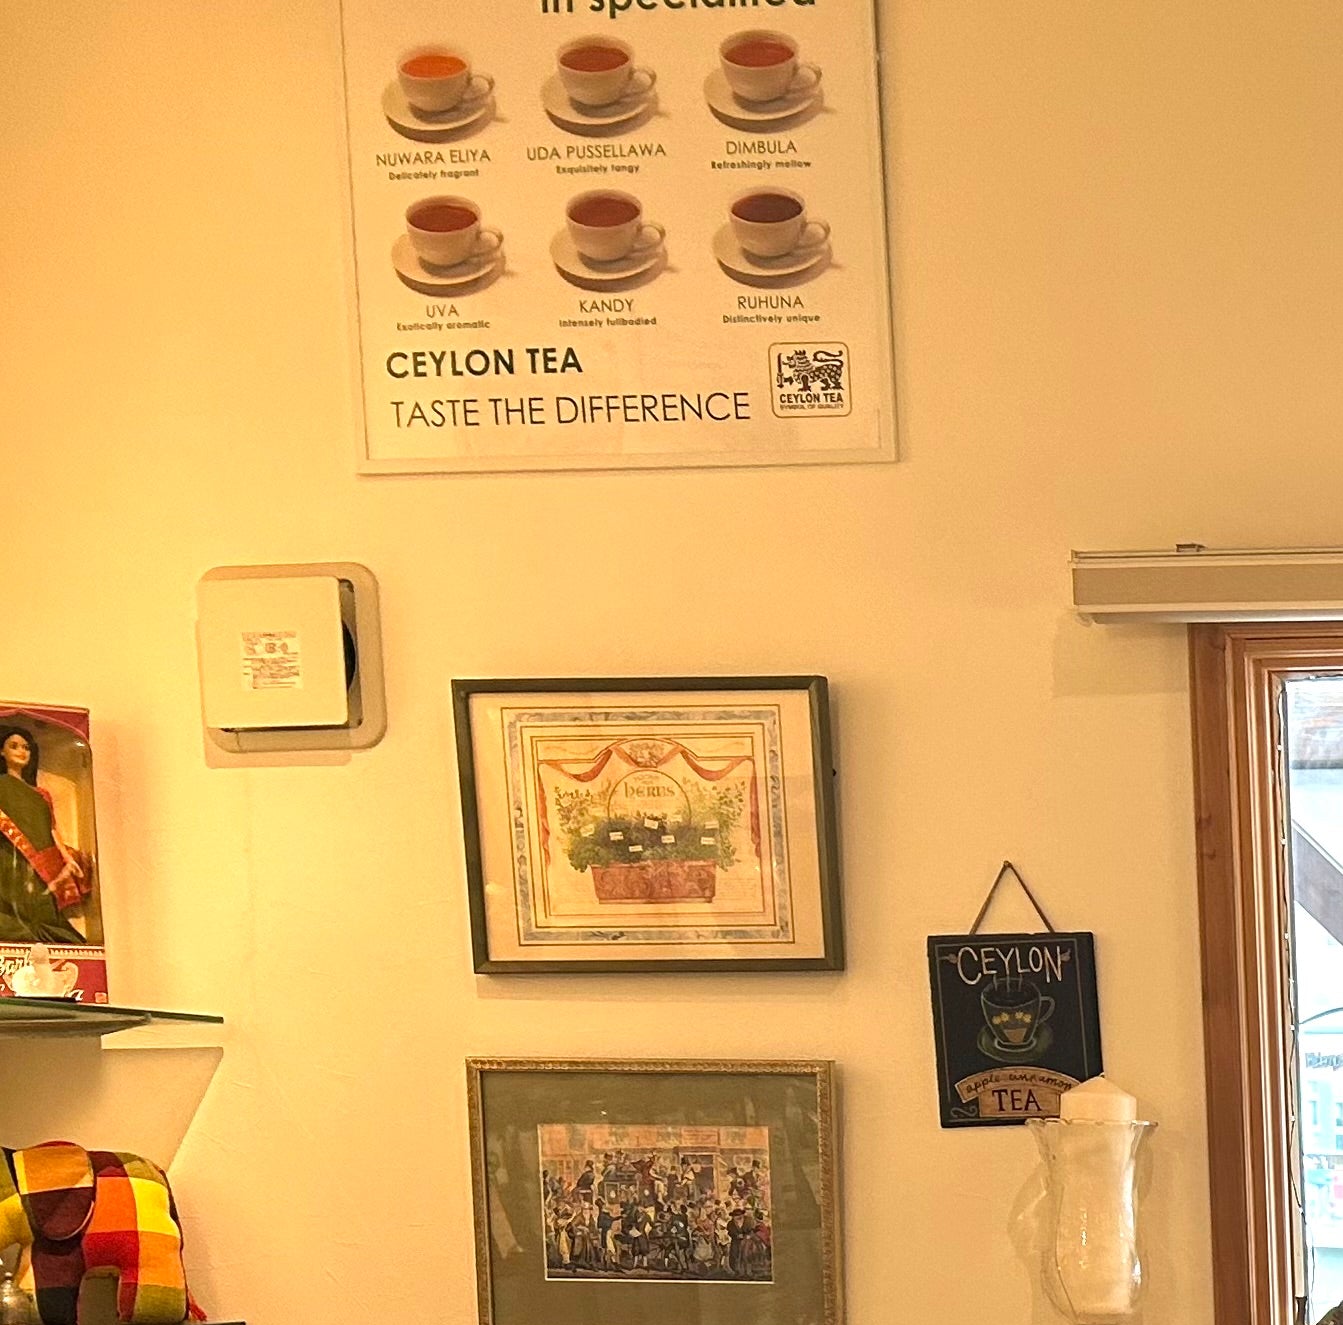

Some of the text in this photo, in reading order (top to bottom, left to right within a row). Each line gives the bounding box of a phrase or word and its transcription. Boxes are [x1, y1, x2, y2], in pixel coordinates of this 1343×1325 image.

[527, 143, 667, 161] UDA PUSSELLAWA
[726, 140, 797, 155] DIMBULA
[376, 148, 492, 167] NUWARA ELIYA
[556, 163, 640, 176] Exquisitely tangy
[711, 159, 812, 171] Refreshingly mellow
[389, 168, 480, 181] Delicately fragrant
[579, 299, 635, 313] KANDY
[737, 295, 804, 310] RUHUNA
[426, 304, 460, 318] UVA
[396, 319, 491, 333] Exotically aromatic
[558, 315, 657, 329] Intensely fullbodied
[722, 313, 821, 325] Distinctively unique
[385, 347, 584, 379] CEYLON TEA
[779, 392, 844, 405] CEYLON TEA
[391, 393, 751, 428] TASTE THE DIFFERENCE
[957, 945, 1064, 985] CEYLON
[966, 1073, 1001, 1093] apple
[992, 1088, 1042, 1112] TEA
